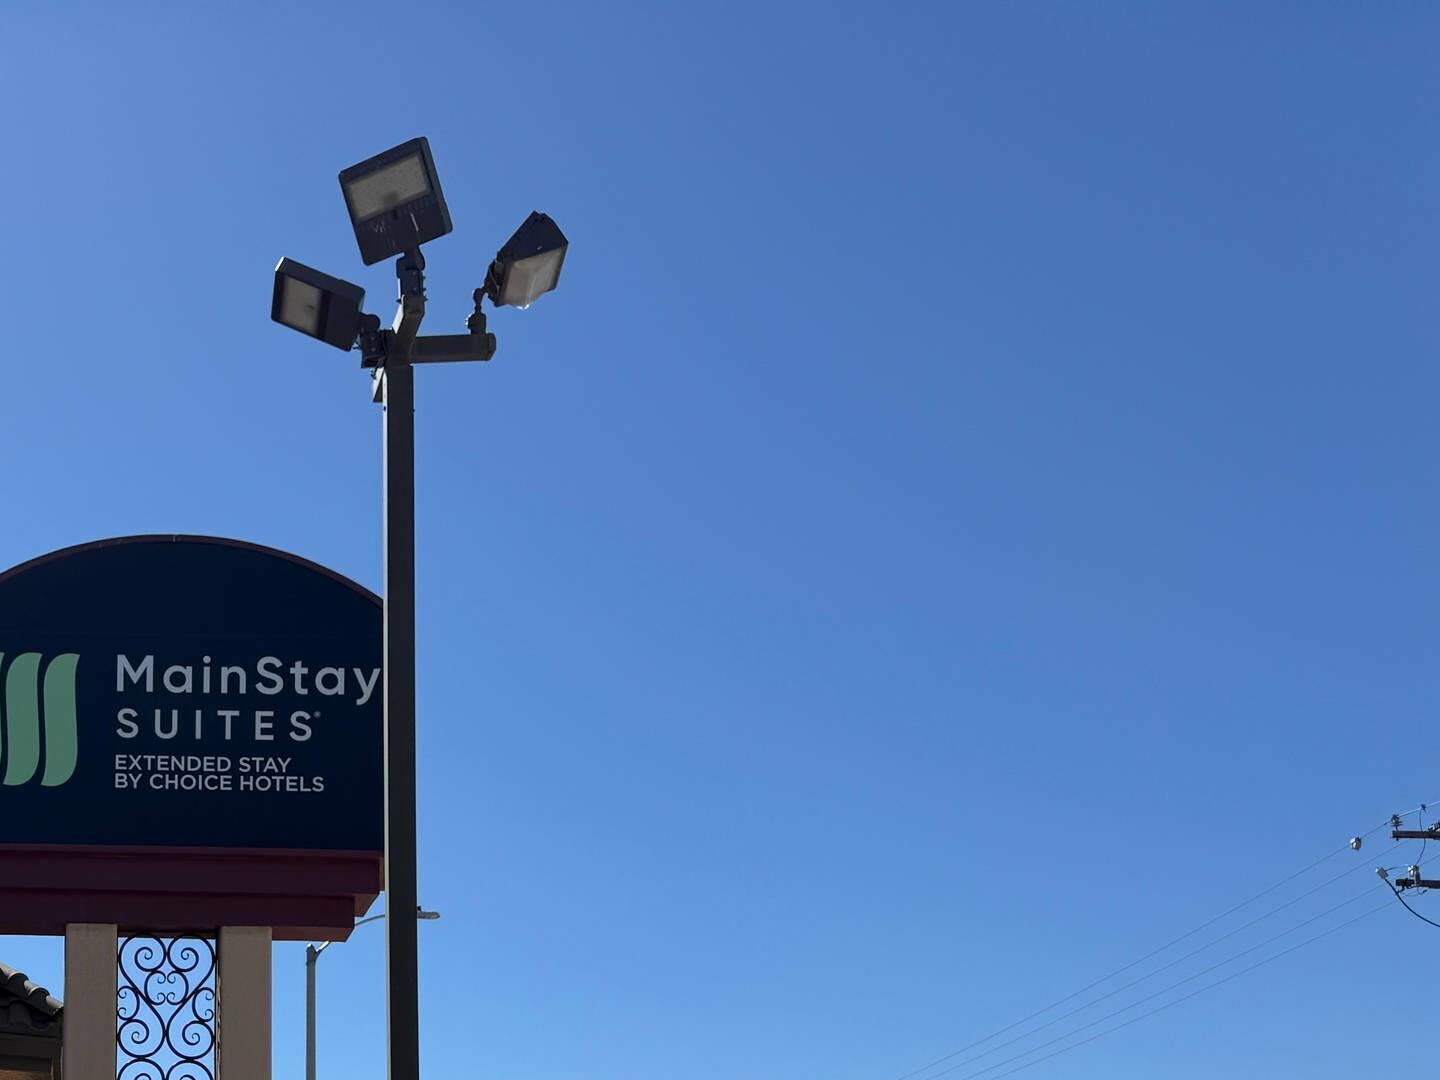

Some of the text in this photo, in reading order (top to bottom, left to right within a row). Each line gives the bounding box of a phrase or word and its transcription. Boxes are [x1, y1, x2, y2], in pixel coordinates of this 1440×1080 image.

[116, 654, 382, 705] MainStay
[114, 754, 292, 773] EXTENDED STAY
[114, 773, 325, 792] BY CHOICE HOTELS
